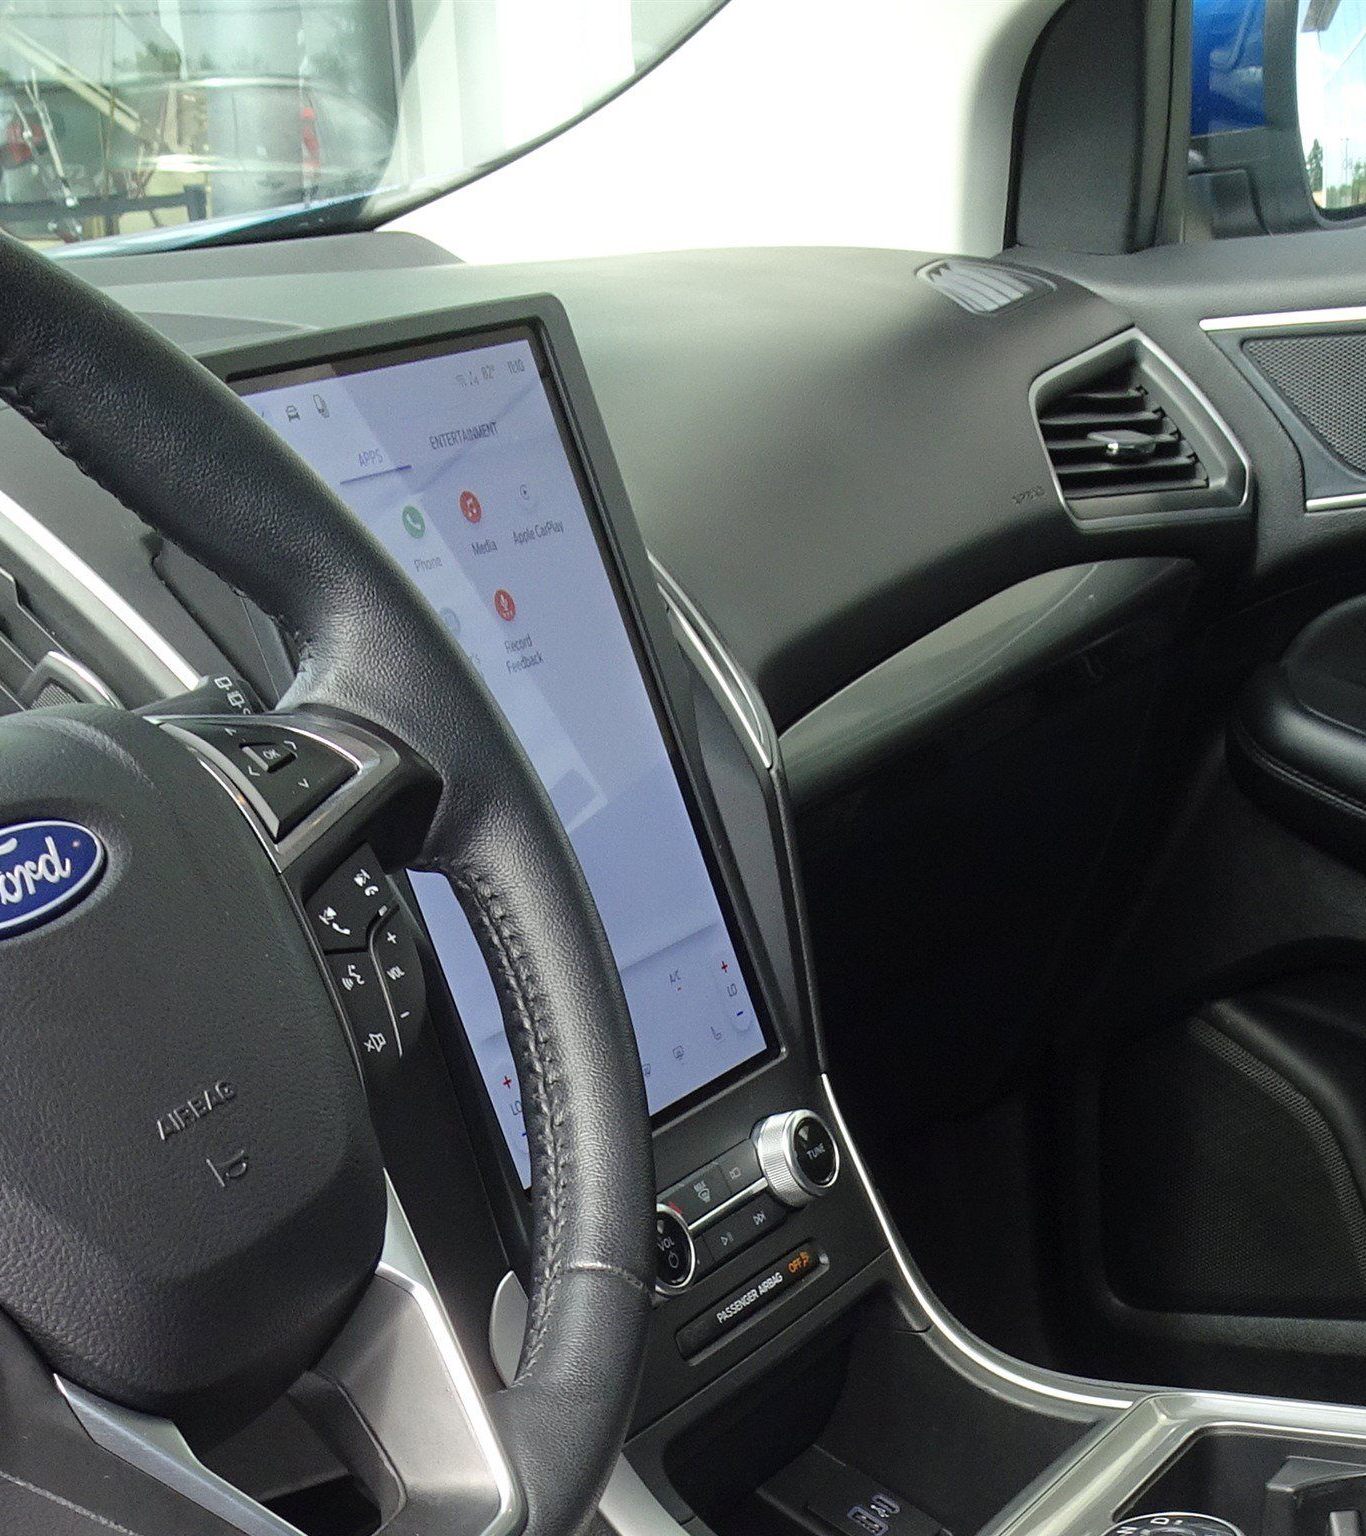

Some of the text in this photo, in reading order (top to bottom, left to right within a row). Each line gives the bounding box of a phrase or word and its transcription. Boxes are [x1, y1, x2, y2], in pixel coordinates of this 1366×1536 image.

[429, 421, 498, 450] ENTERTAINMENT
[358, 448, 383, 467] APPS
[471, 539, 498, 557] Media
[414, 556, 443, 572] Phone
[387, 965, 405, 980] VOL
[716, 1288, 759, 1324] PASSENGER
[757, 1271, 783, 1295] AIRBAG
